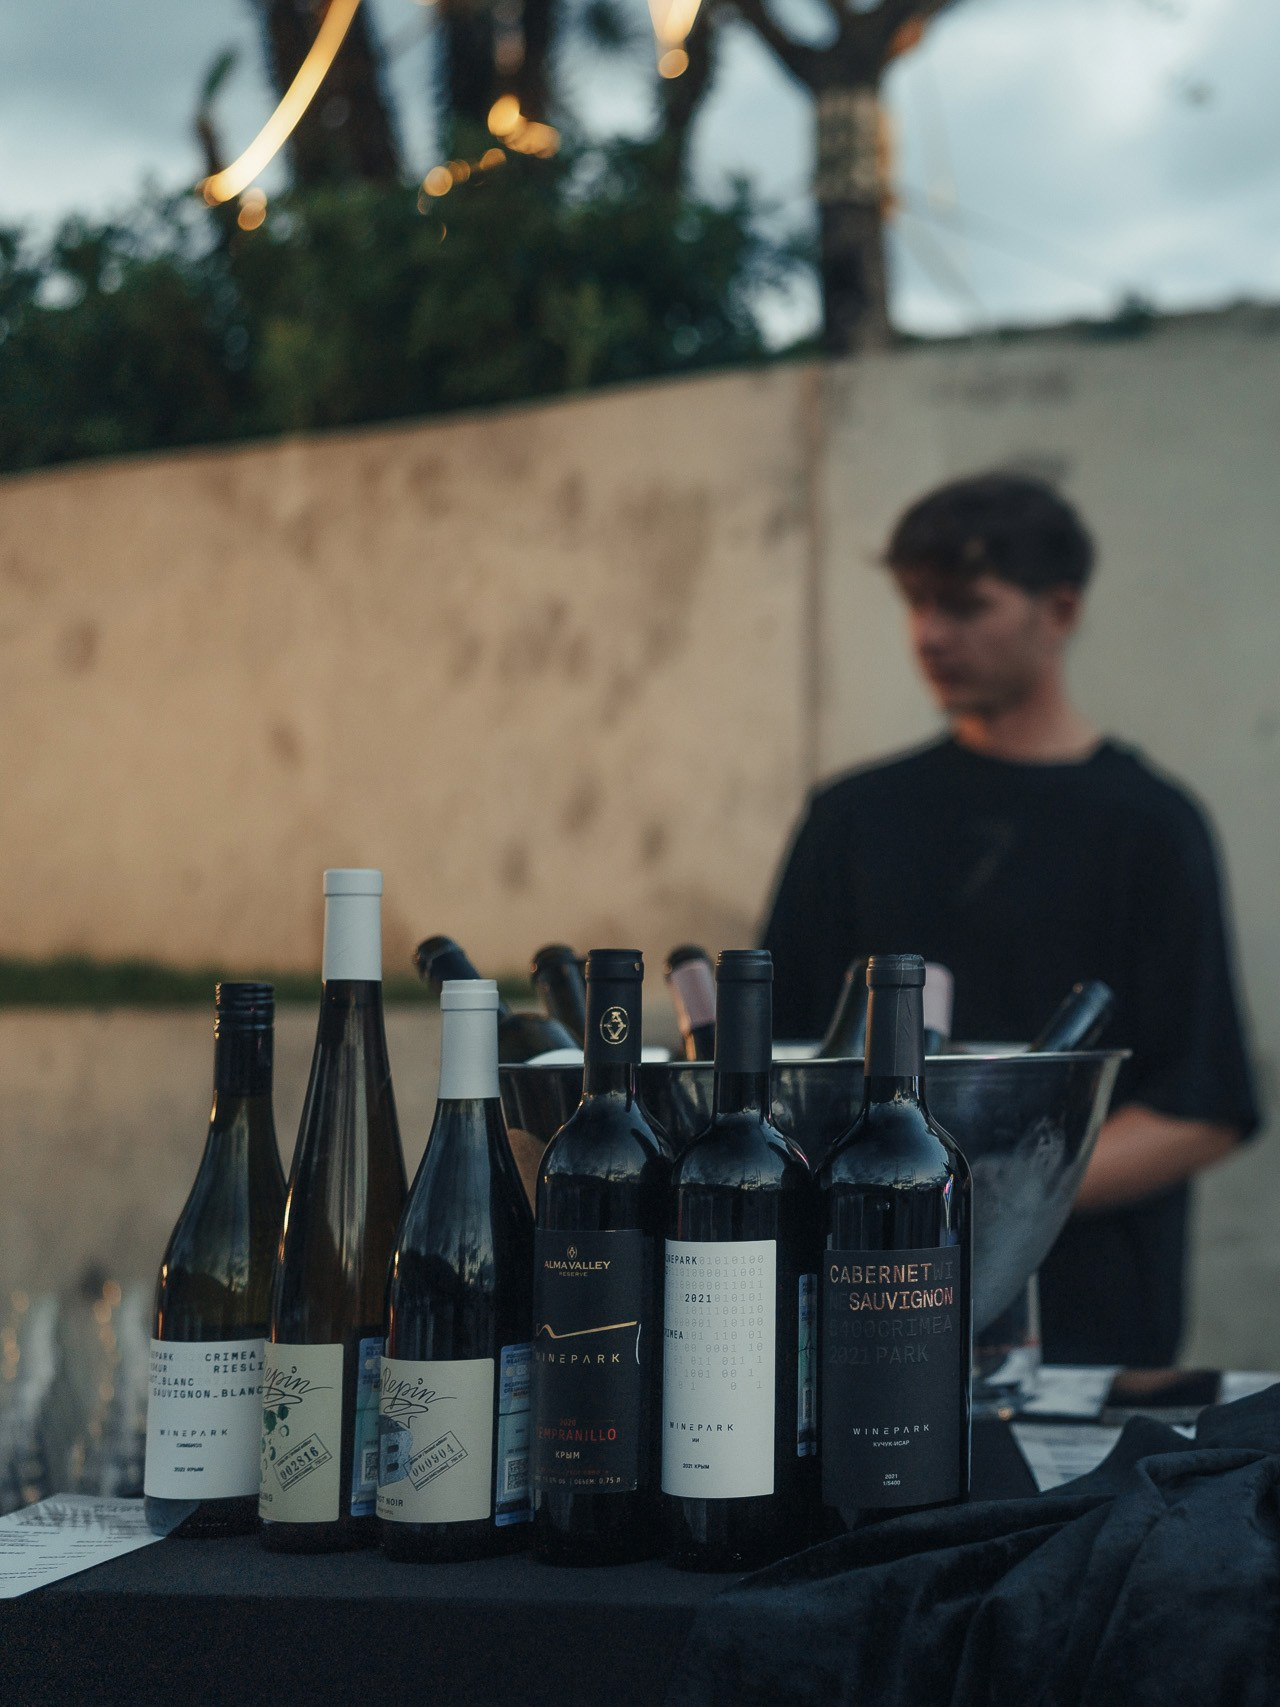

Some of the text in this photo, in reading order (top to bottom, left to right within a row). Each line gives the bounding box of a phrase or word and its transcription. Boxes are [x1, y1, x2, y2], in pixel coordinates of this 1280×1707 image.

[544, 1261, 611, 1270] ALMA VALLEY
[830, 1263, 932, 1284] CABERNET
[684, 1293, 712, 1303] 2021
[849, 1286, 953, 1311] SAUVIGNON
[204, 1350, 257, 1361] CRIMEA
[213, 1362, 263, 1373] RIESLI
[670, 1421, 735, 1432] WINEPARK
[853, 1424, 930, 1435] WINEPARK
[160, 1429, 229, 1437] WINEPARK
[411, 1443, 456, 1477] 000904
[555, 1451, 581, 1459] КРЫМ
[280, 1446, 320, 1480] 002816
[386, 1498, 404, 1507] NOIR
